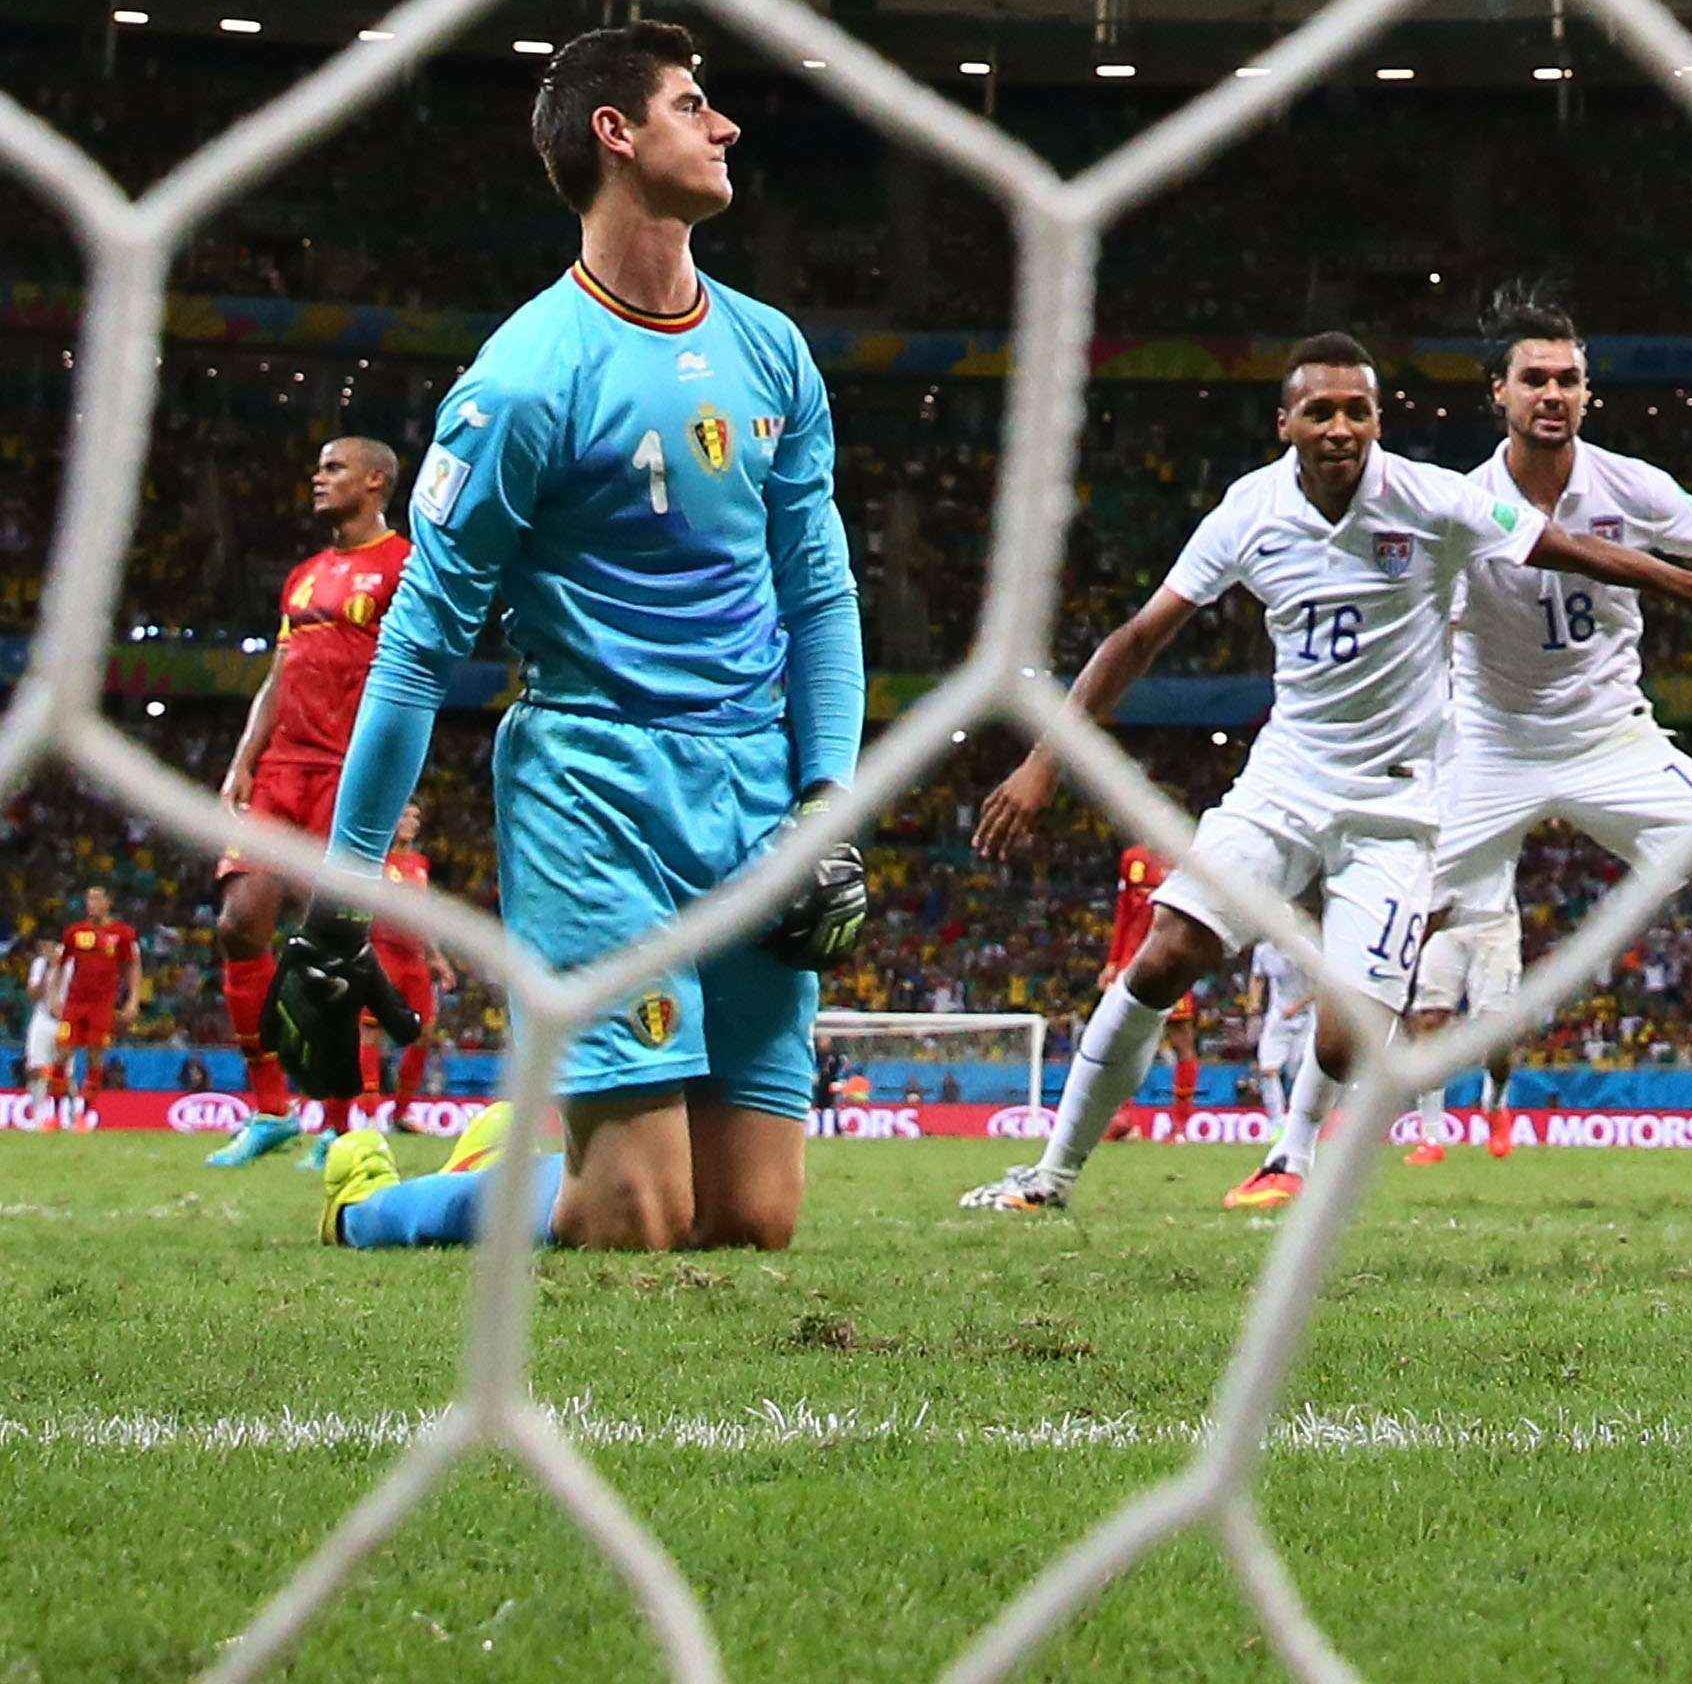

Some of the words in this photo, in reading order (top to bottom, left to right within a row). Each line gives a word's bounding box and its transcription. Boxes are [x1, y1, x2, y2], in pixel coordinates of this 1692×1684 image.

[632, 428, 669, 515] 1
[1297, 600, 1364, 663] 16
[1538, 592, 1597, 652] 18
